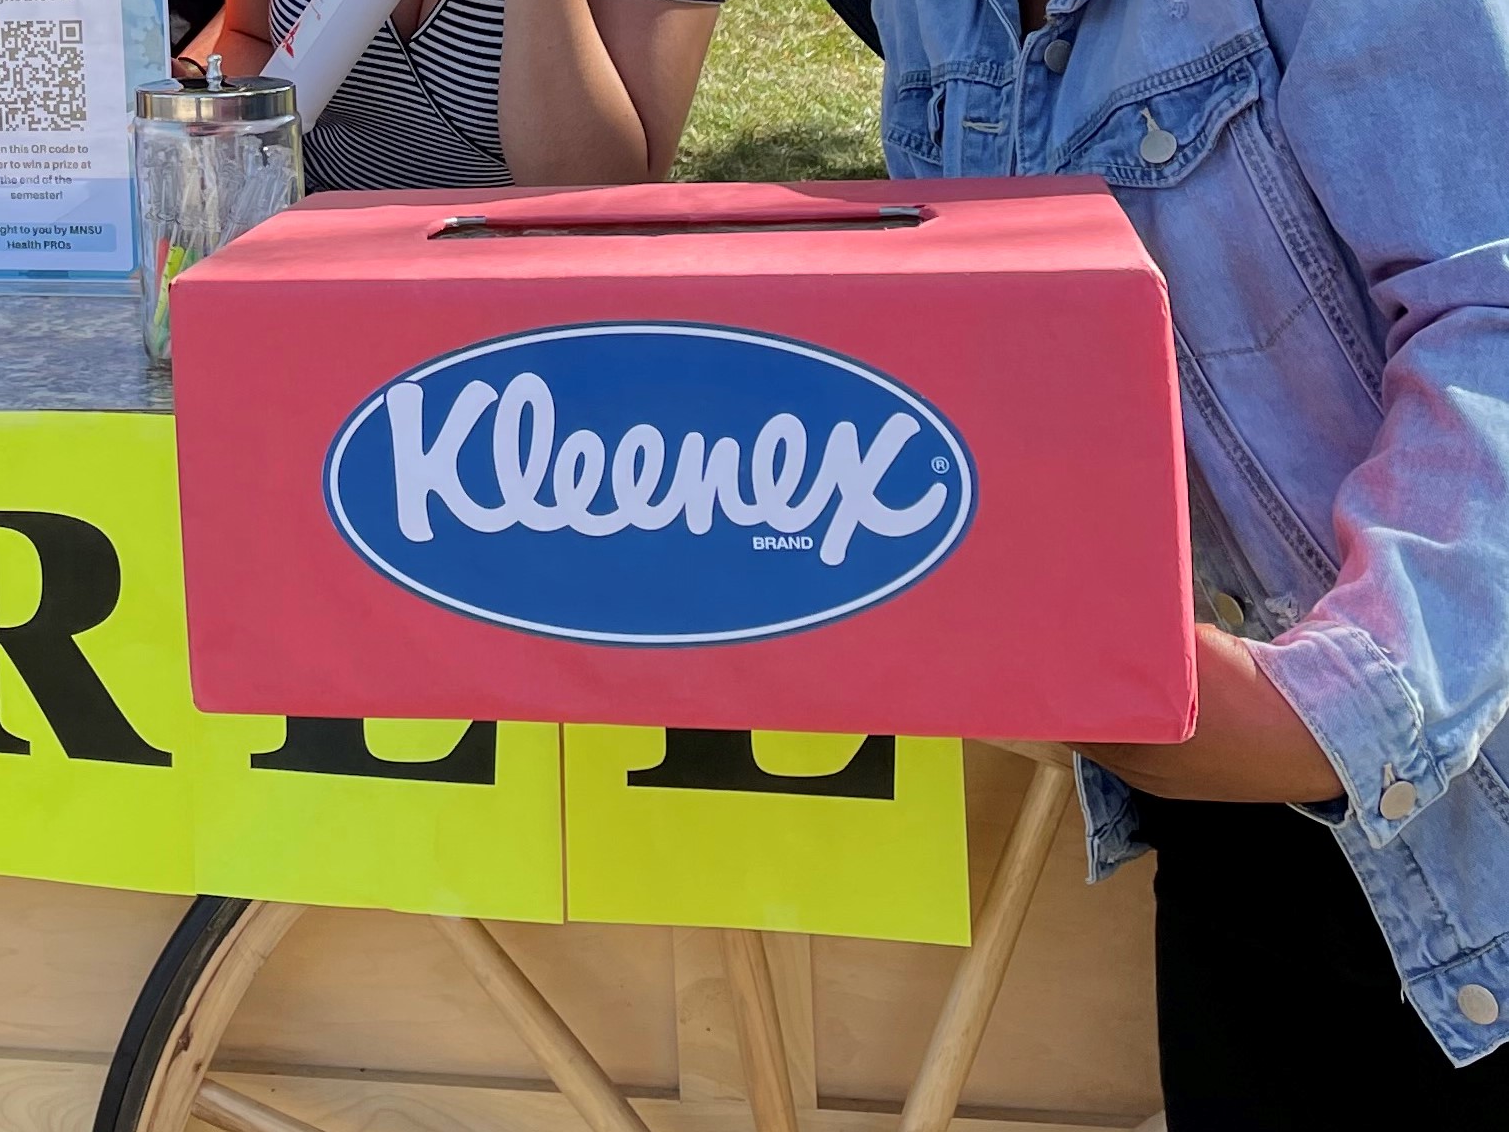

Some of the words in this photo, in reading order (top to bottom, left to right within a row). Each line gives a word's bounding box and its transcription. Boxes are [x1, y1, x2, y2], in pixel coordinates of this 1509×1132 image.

[9, 144, 29, 154] this
[31, 144, 47, 154] QR
[49, 144, 76, 154] code
[77, 145, 89, 154] to
[9, 160, 21, 170] to
[23, 160, 42, 170] win
[44, 162, 51, 170] a
[53, 160, 78, 172] prize
[80, 160, 91, 170] at
[0, 176, 17, 185] the
[19, 176, 39, 185] end
[41, 175, 53, 185] of
[55, 175, 72, 185] the
[11, 191, 63, 200] semester!
[20, 226, 31, 235] to
[33, 227, 52, 237] you
[54, 225, 67, 237] by
[69, 226, 103, 235] MNSU
[7, 240, 41, 250] Health
[44, 240, 72, 250] PROs
[386, 372, 948, 566] Kleenex
[751, 536, 813, 551] BRAND
